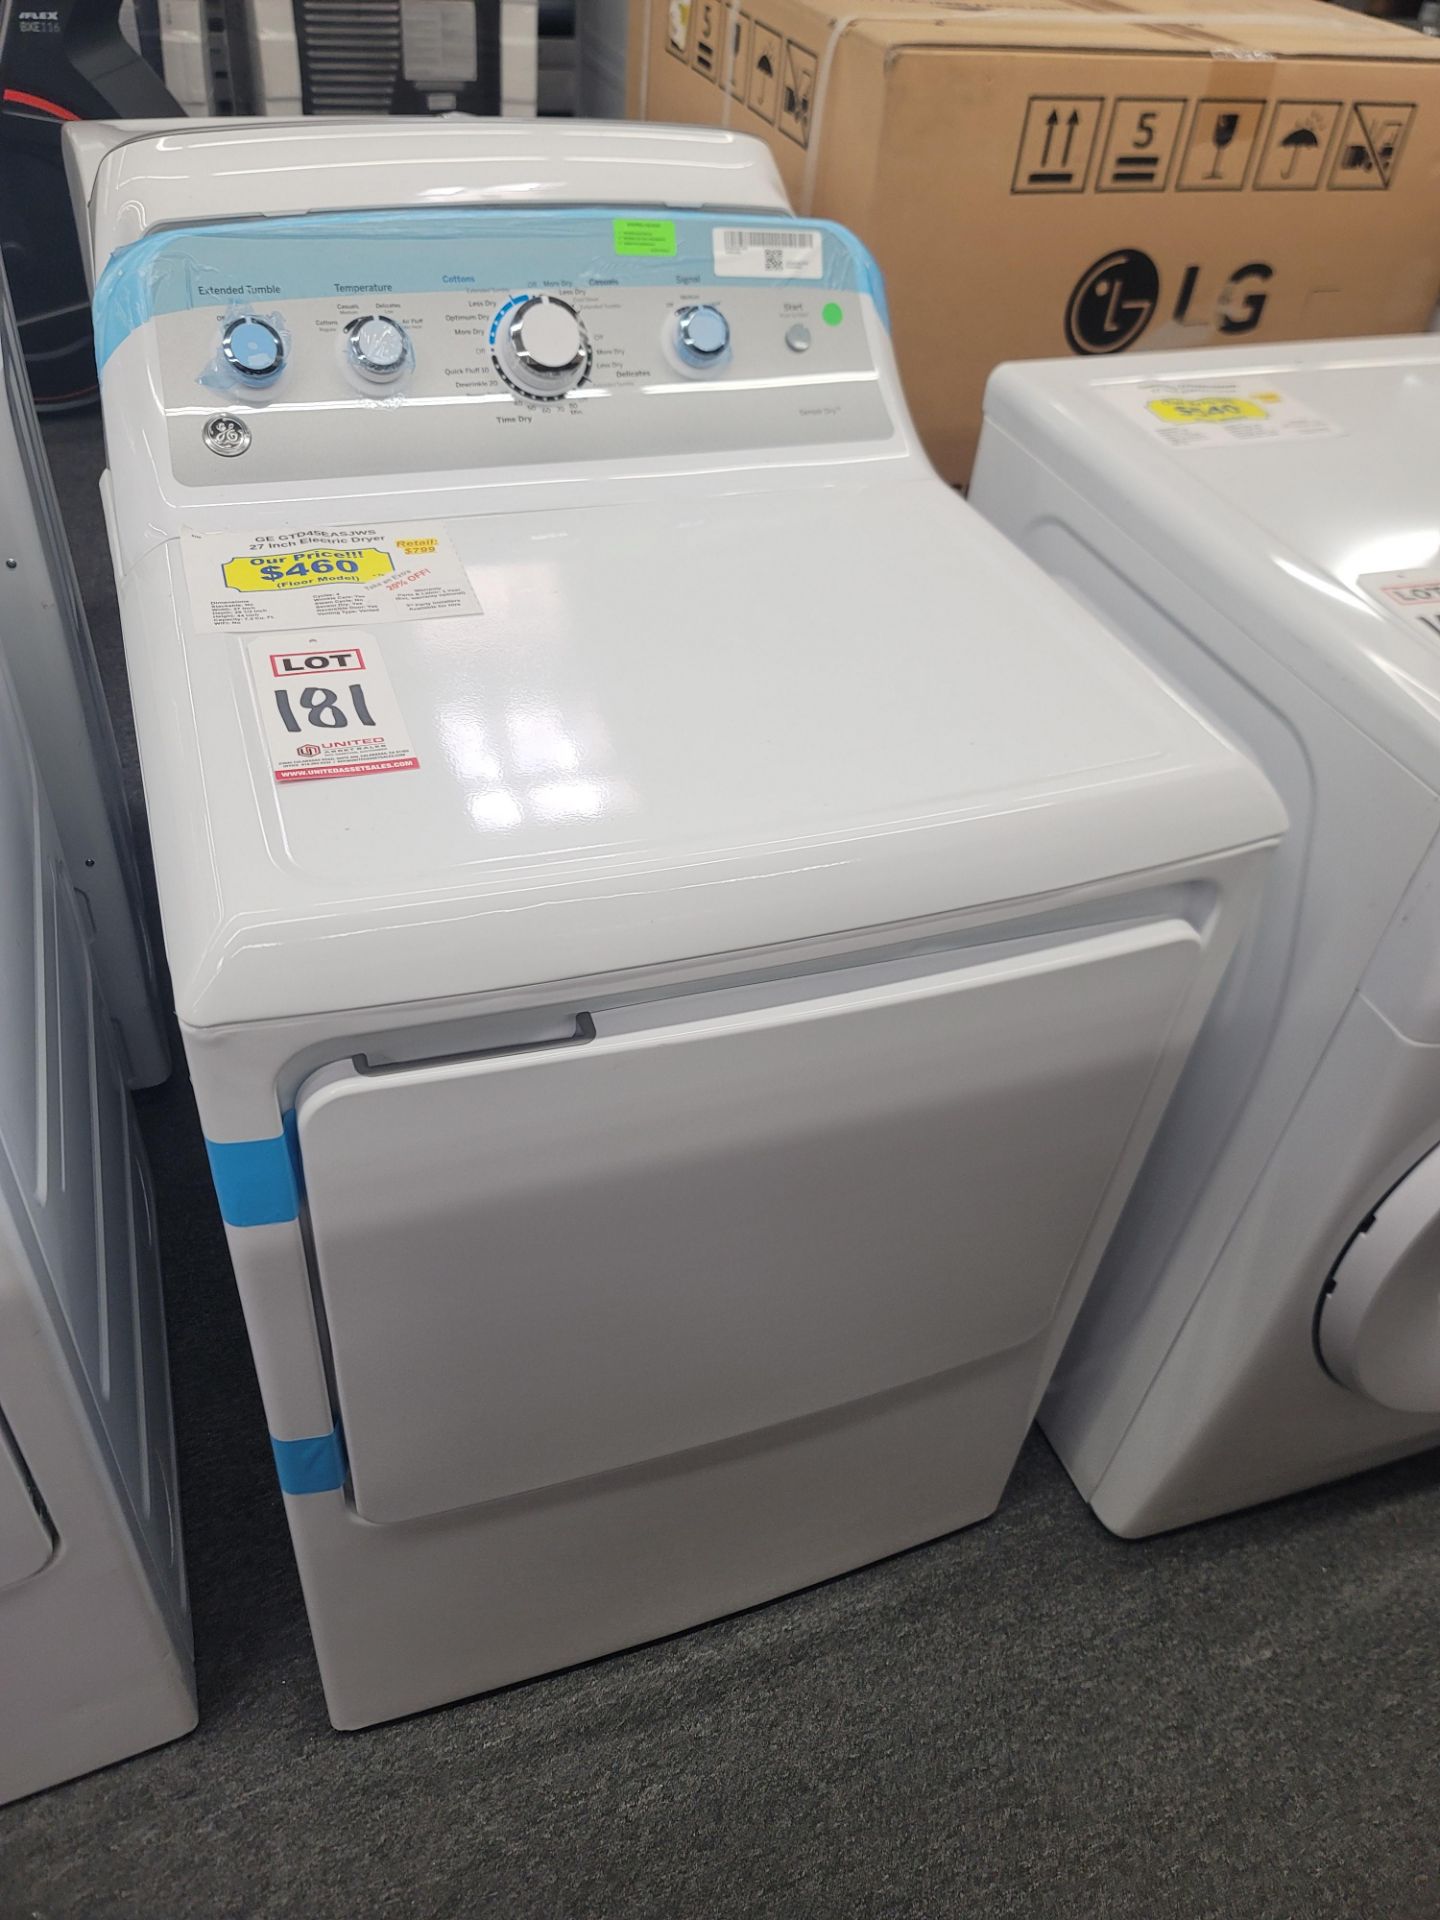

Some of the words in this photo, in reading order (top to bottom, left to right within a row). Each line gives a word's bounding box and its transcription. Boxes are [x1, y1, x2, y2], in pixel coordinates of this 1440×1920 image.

[1133, 113, 1157, 148] 5
[442, 275, 476, 284] Cottons
[561, 280, 573, 288] Dry
[198, 286, 245, 295] Extended
[245, 285, 281, 294] Tumble
[334, 283, 392, 293] Temperature
[574, 289, 586, 297] Dry
[1172, 262, 1274, 335] LG
[485, 300, 496, 308] Dry
[784, 303, 802, 311] Start
[478, 314, 490, 322] Dry
[473, 328, 484, 336] Dry
[613, 348, 625, 356] Dry
[445, 368, 463, 376] Quick
[496, 416, 516, 424] Time
[518, 415, 532, 424] Dry
[300, 536, 348, 545] Electric
[351, 535, 385, 543] Dryer
[396, 539, 438, 547] Retail:
[250, 557, 287, 566] Our
[293, 551, 364, 561] Price!!!
[260, 559, 359, 582] $460
[407, 568, 431, 582] OFF!
[277, 580, 313, 588] (Floor
[283, 654, 352, 672] LOT
[274, 684, 376, 733] 181
[321, 737, 385, 749] UNITED
[281, 760, 413, 778] WWW.UNITEDASSETSALES.COM
